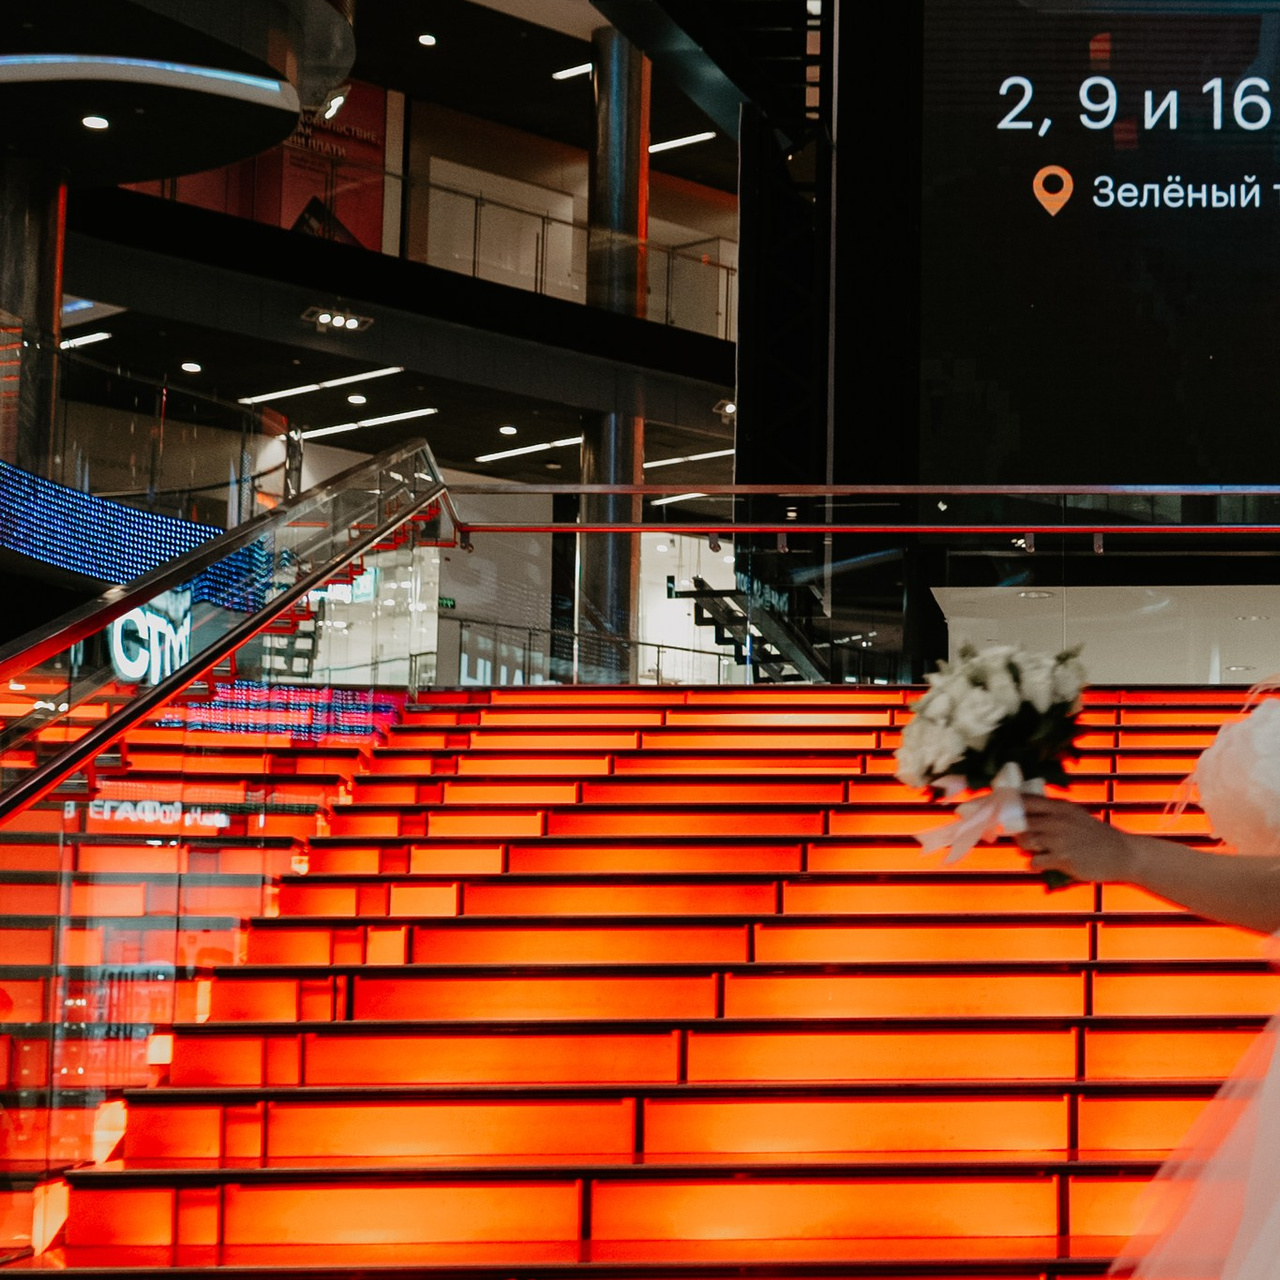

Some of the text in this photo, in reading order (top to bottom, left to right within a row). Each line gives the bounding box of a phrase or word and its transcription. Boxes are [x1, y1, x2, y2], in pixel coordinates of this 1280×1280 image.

[996, 77, 1053, 138] 2,
[1077, 76, 1119, 131] 9
[1143, 89, 1179, 131] и
[1200, 76, 1273, 131] 16
[1092, 175, 1261, 209] Зелёный
